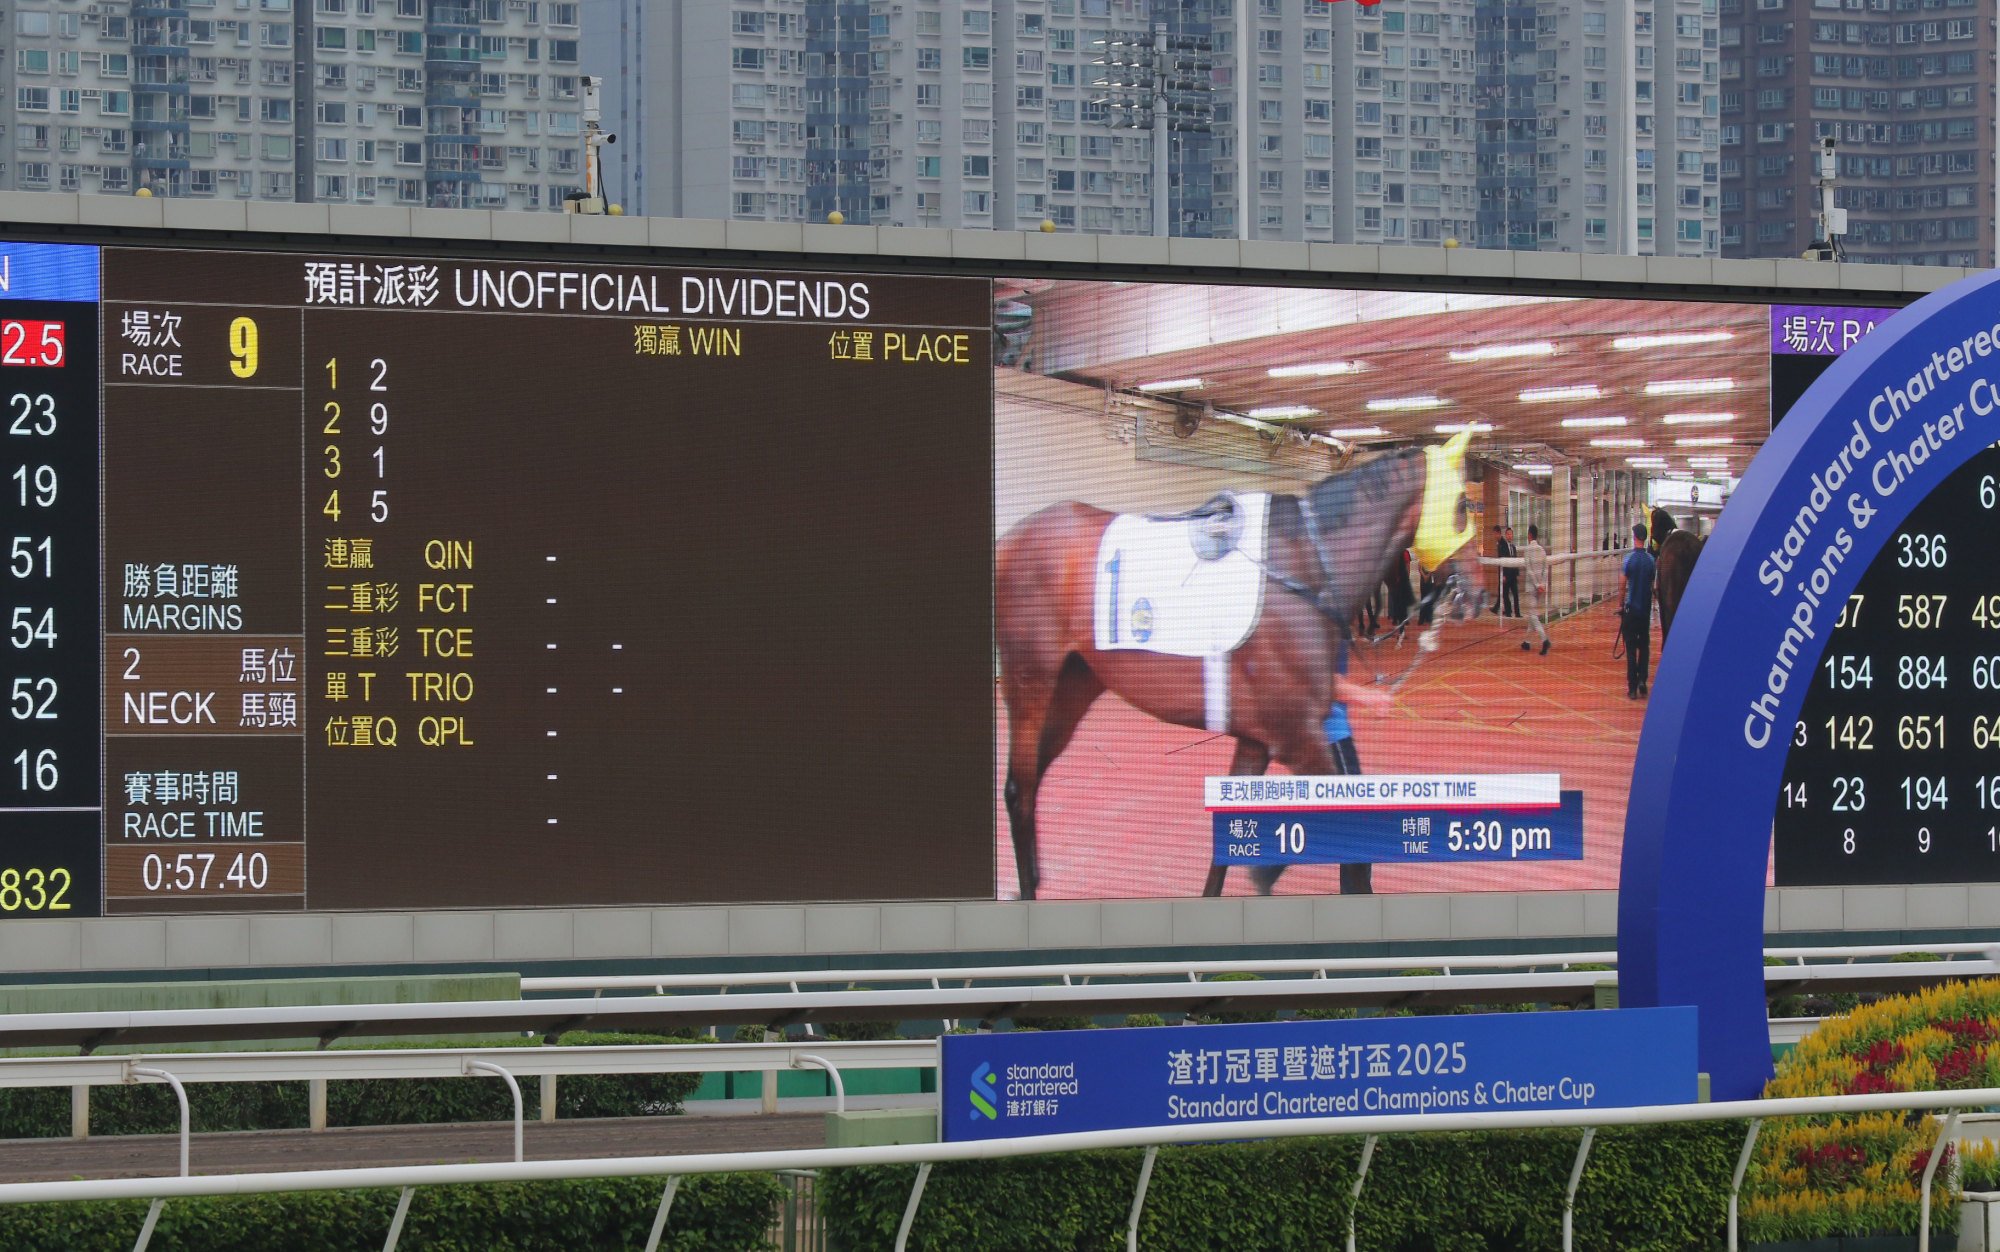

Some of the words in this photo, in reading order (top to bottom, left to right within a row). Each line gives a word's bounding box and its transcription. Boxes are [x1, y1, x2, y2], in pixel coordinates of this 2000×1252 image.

[304, 263, 440, 306] 預計派彩
[455, 269, 669, 314] UNOFFICIAL
[681, 277, 870, 319] DIVIDENDS
[2, 321, 63, 365] 2.5
[121, 311, 182, 347] 場次
[634, 325, 681, 356] 獨贏
[689, 326, 741, 356] WIN
[1783, 316, 1835, 353] 場次
[229, 316, 259, 378] 9
[828, 330, 874, 361] 位置
[884, 333, 970, 363] PLACE
[122, 354, 182, 377] RACE
[325, 358, 336, 390] 1
[370, 359, 387, 391] 2
[9, 393, 57, 435] 23
[323, 402, 341, 434] 2
[370, 403, 388, 435] 9
[323, 446, 341, 478] 3
[372, 446, 384, 478] 1
[12, 465, 57, 507] 19
[323, 490, 341, 522] 4
[370, 490, 388, 523] 5
[1758, 420, 1871, 596] Standard
[10, 536, 53, 578] 51
[324, 537, 373, 570] 連贏
[424, 539, 473, 571] QIN
[1898, 534, 1947, 568] 336
[123, 563, 238, 599] 勝負距離
[1744, 527, 1853, 749] Champions
[1848, 493, 1878, 529] &
[1872, 403, 1964, 496] Chater
[324, 582, 399, 614] 二重彩
[418, 583, 474, 613] FCT
[1104, 548, 1120, 643] 1
[1898, 595, 1947, 629] 587
[10, 607, 57, 649] 54
[123, 604, 243, 631] MARGINS
[324, 627, 399, 659] 三重彩
[417, 628, 474, 657] TCE
[123, 648, 141, 680] 2
[239, 648, 297, 684] 馬位
[1824, 655, 1873, 689] 154
[1898, 656, 1948, 689] 884
[10, 678, 58, 719] 52
[326, 671, 349, 702] 單
[357, 673, 376, 701] T
[406, 672, 474, 702] TRIO
[123, 691, 216, 724] NECK
[239, 692, 297, 728] 馬頸
[324, 716, 397, 747] 位置Q
[418, 716, 474, 747] QPL
[1825, 715, 1874, 750] 142
[1898, 715, 1944, 750] 651
[13, 748, 58, 791] 16
[123, 770, 238, 806] 賽事時間
[1220, 780, 1309, 801] 更改開跑時間
[1315, 783, 1375, 798] CHANGE
[1380, 782, 1398, 798] OF
[1403, 782, 1440, 797] POST
[1444, 781, 1477, 797] TIME
[1784, 782, 1807, 808] 14
[1832, 777, 1866, 812] 23
[1900, 776, 1949, 810] 194
[123, 812, 196, 838] RACE
[204, 811, 264, 837] TIME
[1229, 819, 1258, 839] 場次
[1275, 822, 1305, 854] 10
[1402, 817, 1431, 837] 時間
[1448, 820, 1502, 851] 5:30
[1511, 827, 1551, 858] pm
[1843, 827, 1856, 854] 8
[1918, 827, 1930, 853] 9
[1229, 843, 1261, 857] RACE
[1403, 841, 1429, 854] TIME
[142, 853, 268, 890] 0:57.40
[0, 868, 71, 911] 832
[1006, 1062, 1075, 1081] standard
[1167, 1043, 1392, 1086] 渣打冠軍暨遮打盃
[1397, 1041, 1467, 1076] 2025
[1006, 1078, 1079, 1098] chartered
[1168, 1092, 1259, 1119] Standard
[1264, 1088, 1359, 1117] Chartered
[1363, 1086, 1470, 1115] Champions
[1474, 1082, 1489, 1105] &
[1492, 1080, 1556, 1104] Chater
[1558, 1077, 1596, 1106] Cup
[1006, 1099, 1060, 1118] 渣打銀行
